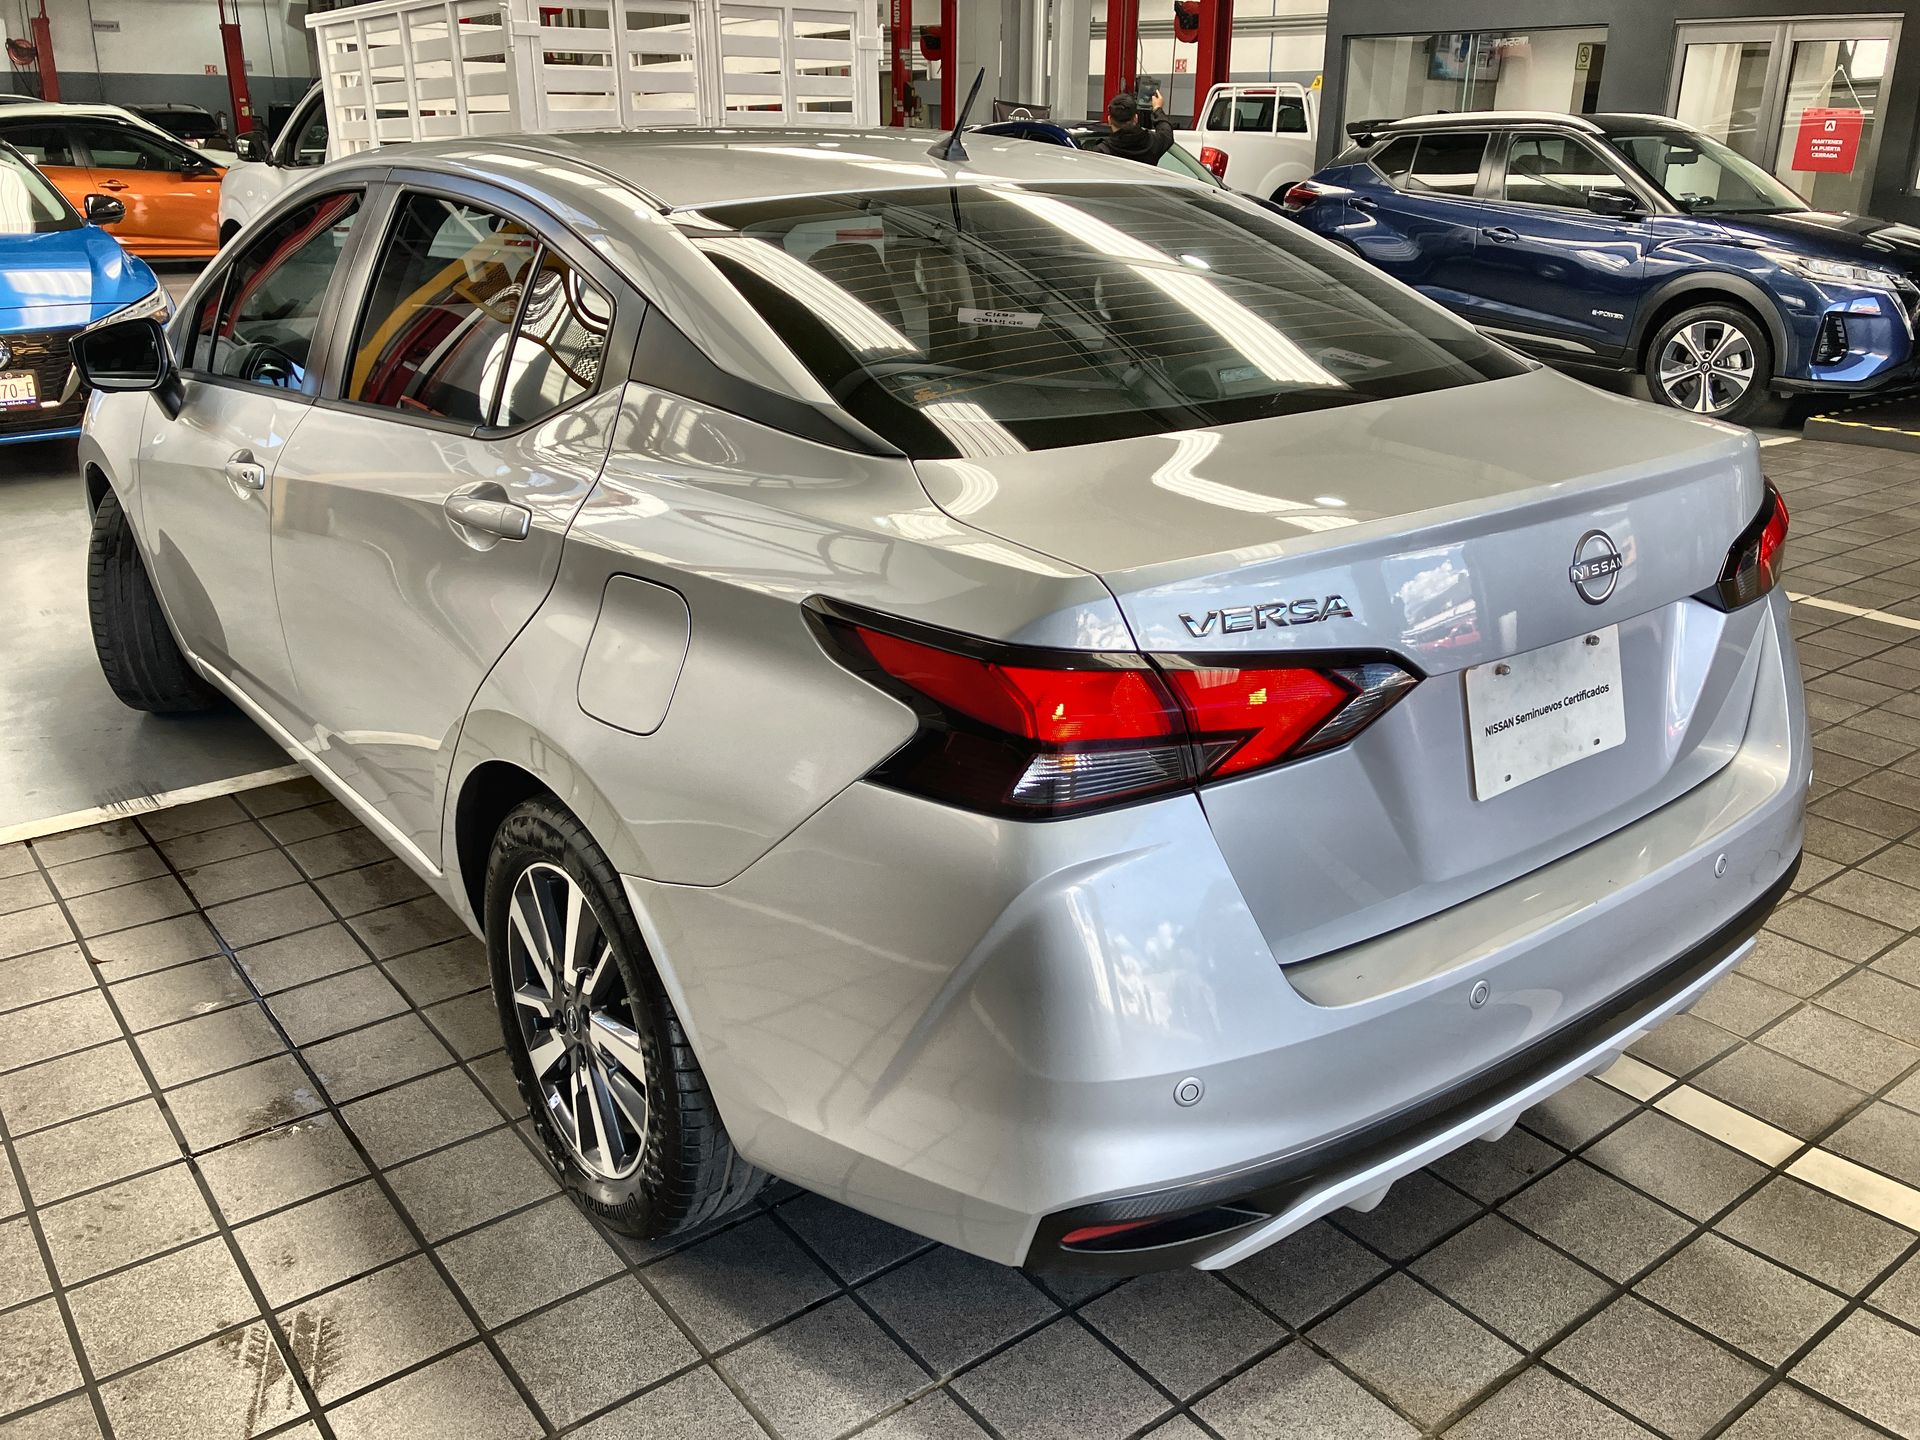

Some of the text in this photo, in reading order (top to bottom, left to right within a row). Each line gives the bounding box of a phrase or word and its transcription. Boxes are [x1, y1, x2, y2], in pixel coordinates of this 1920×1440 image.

[1573, 557, 1623, 580] NISSAN
[1178, 594, 1354, 638] VERSA
[1485, 683, 1610, 737] NISSAN Seminuevos Certificados
